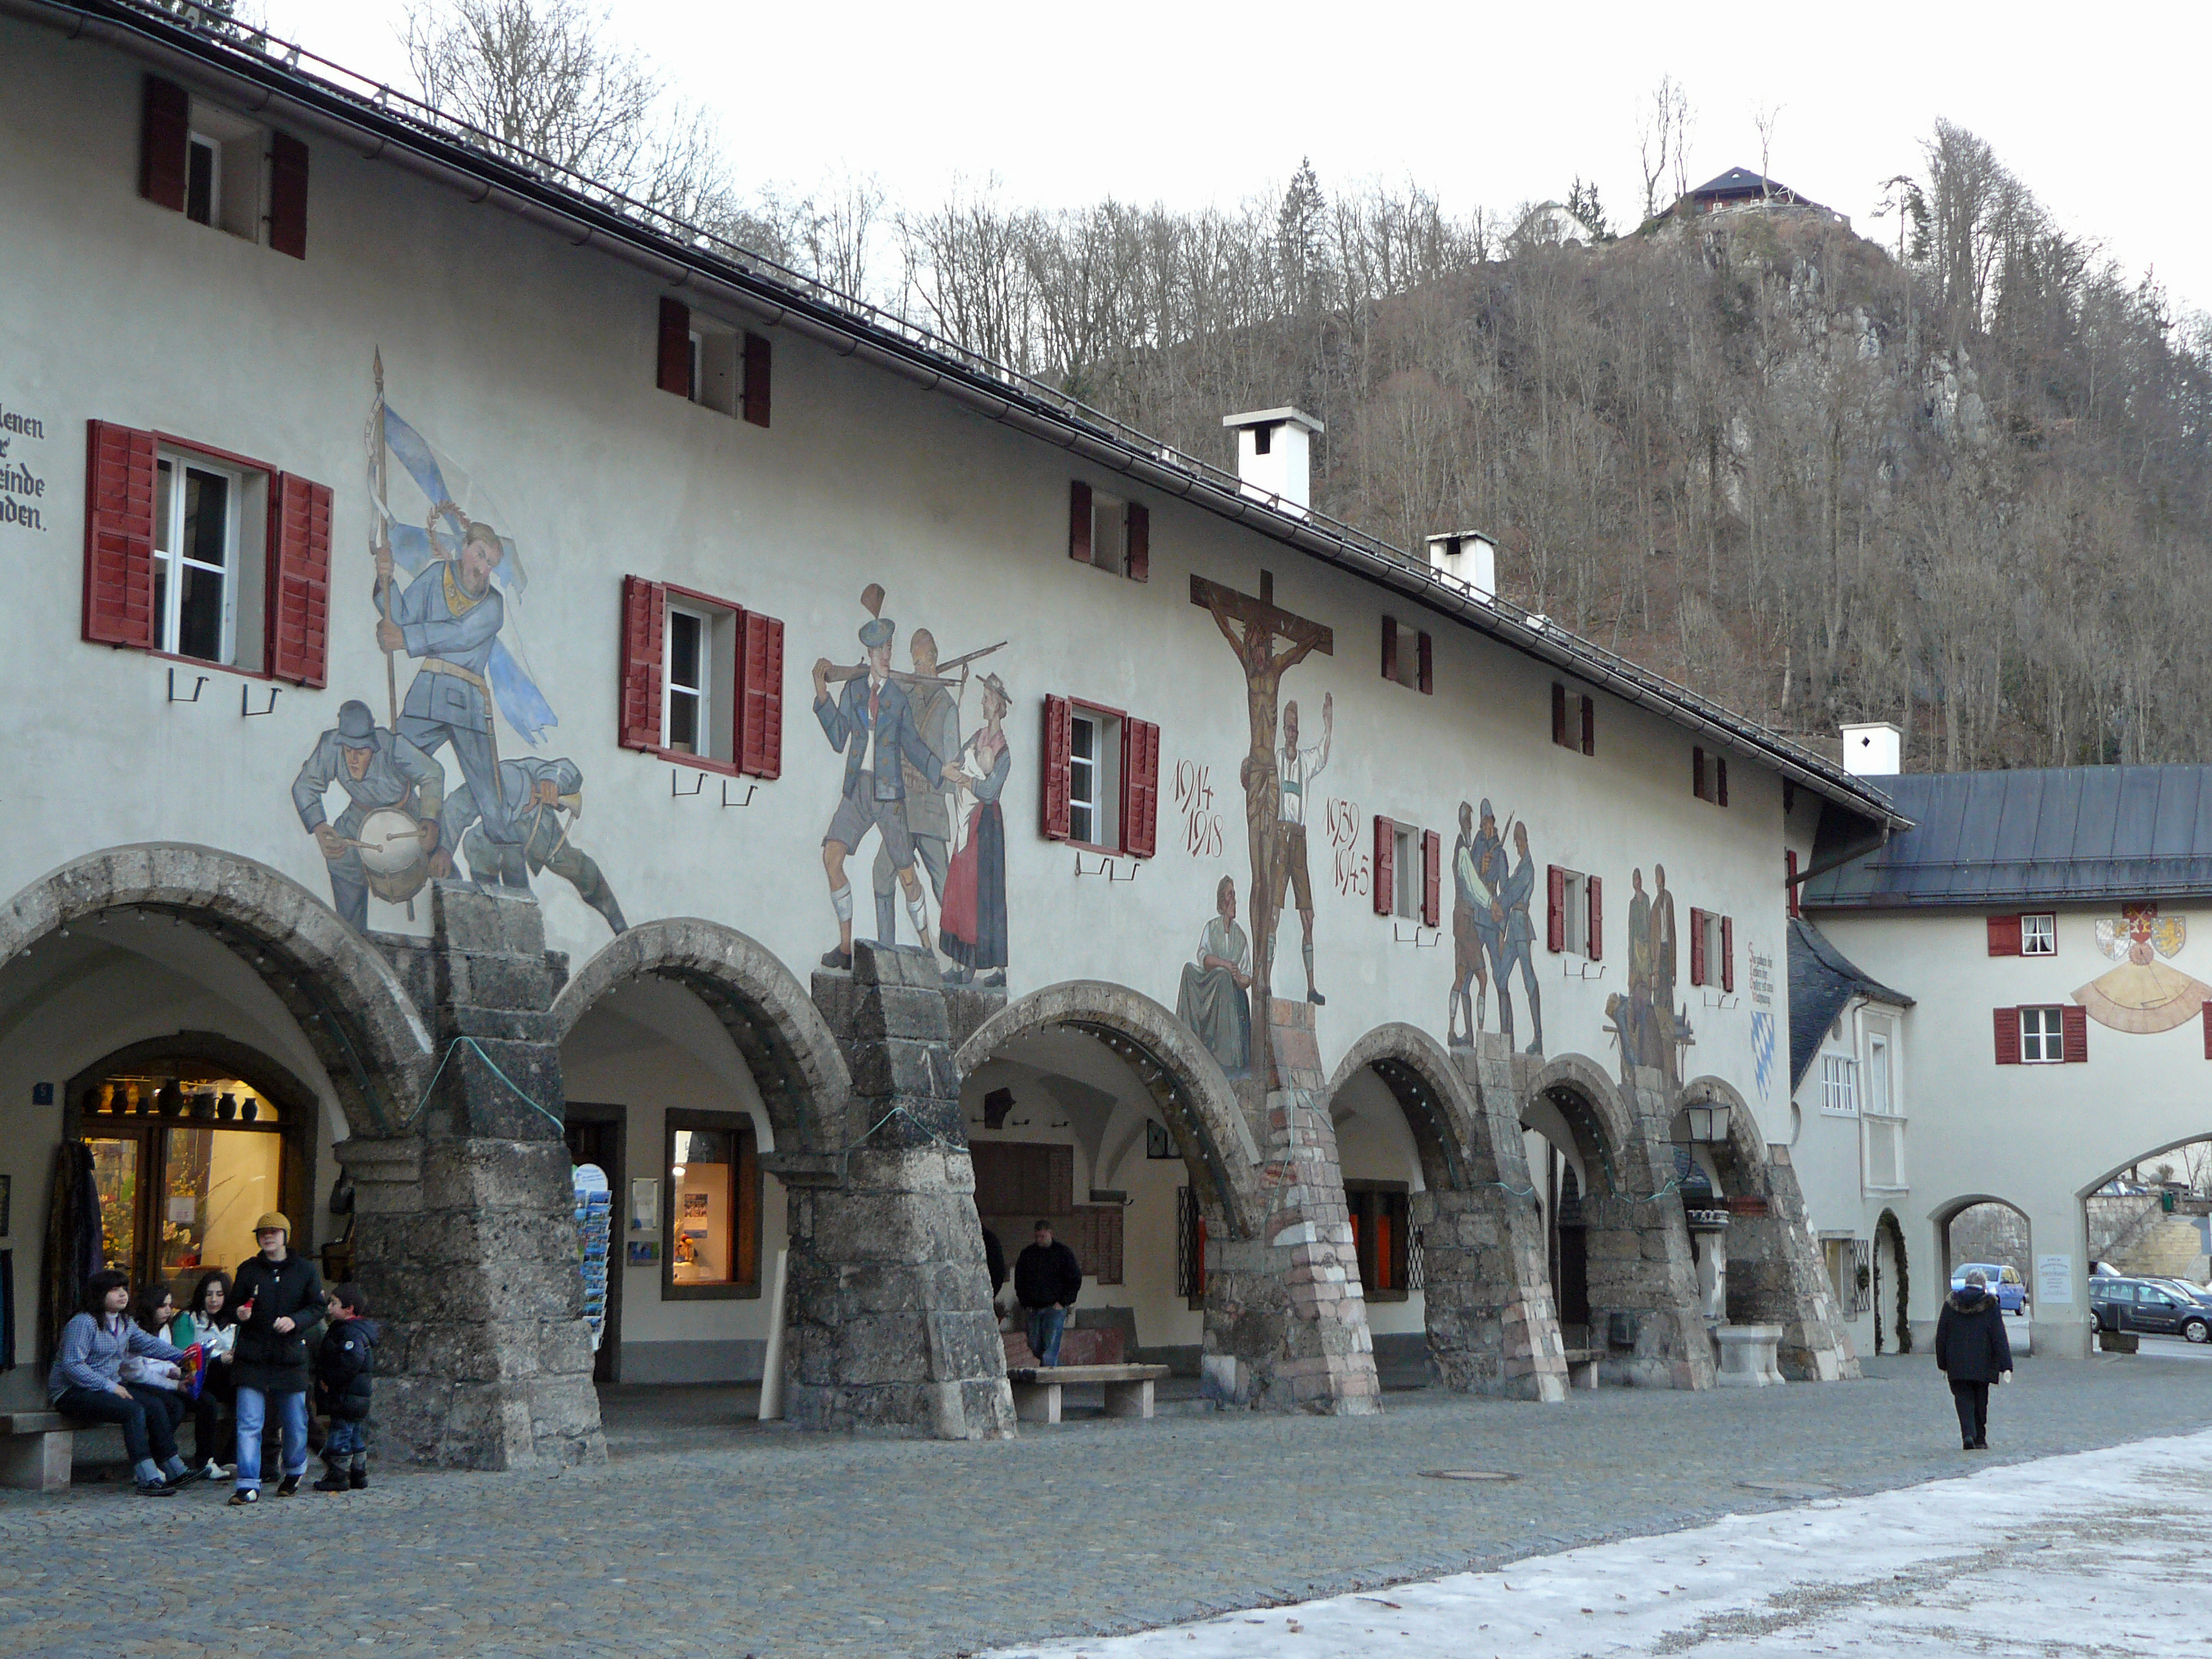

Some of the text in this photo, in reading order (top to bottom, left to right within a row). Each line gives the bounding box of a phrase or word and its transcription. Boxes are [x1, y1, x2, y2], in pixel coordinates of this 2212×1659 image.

[1169, 757, 1214, 814] 1914
[1179, 808, 1224, 858] 1918
[1322, 796, 1360, 851] 1939
[1332, 848, 1369, 896] 1945
